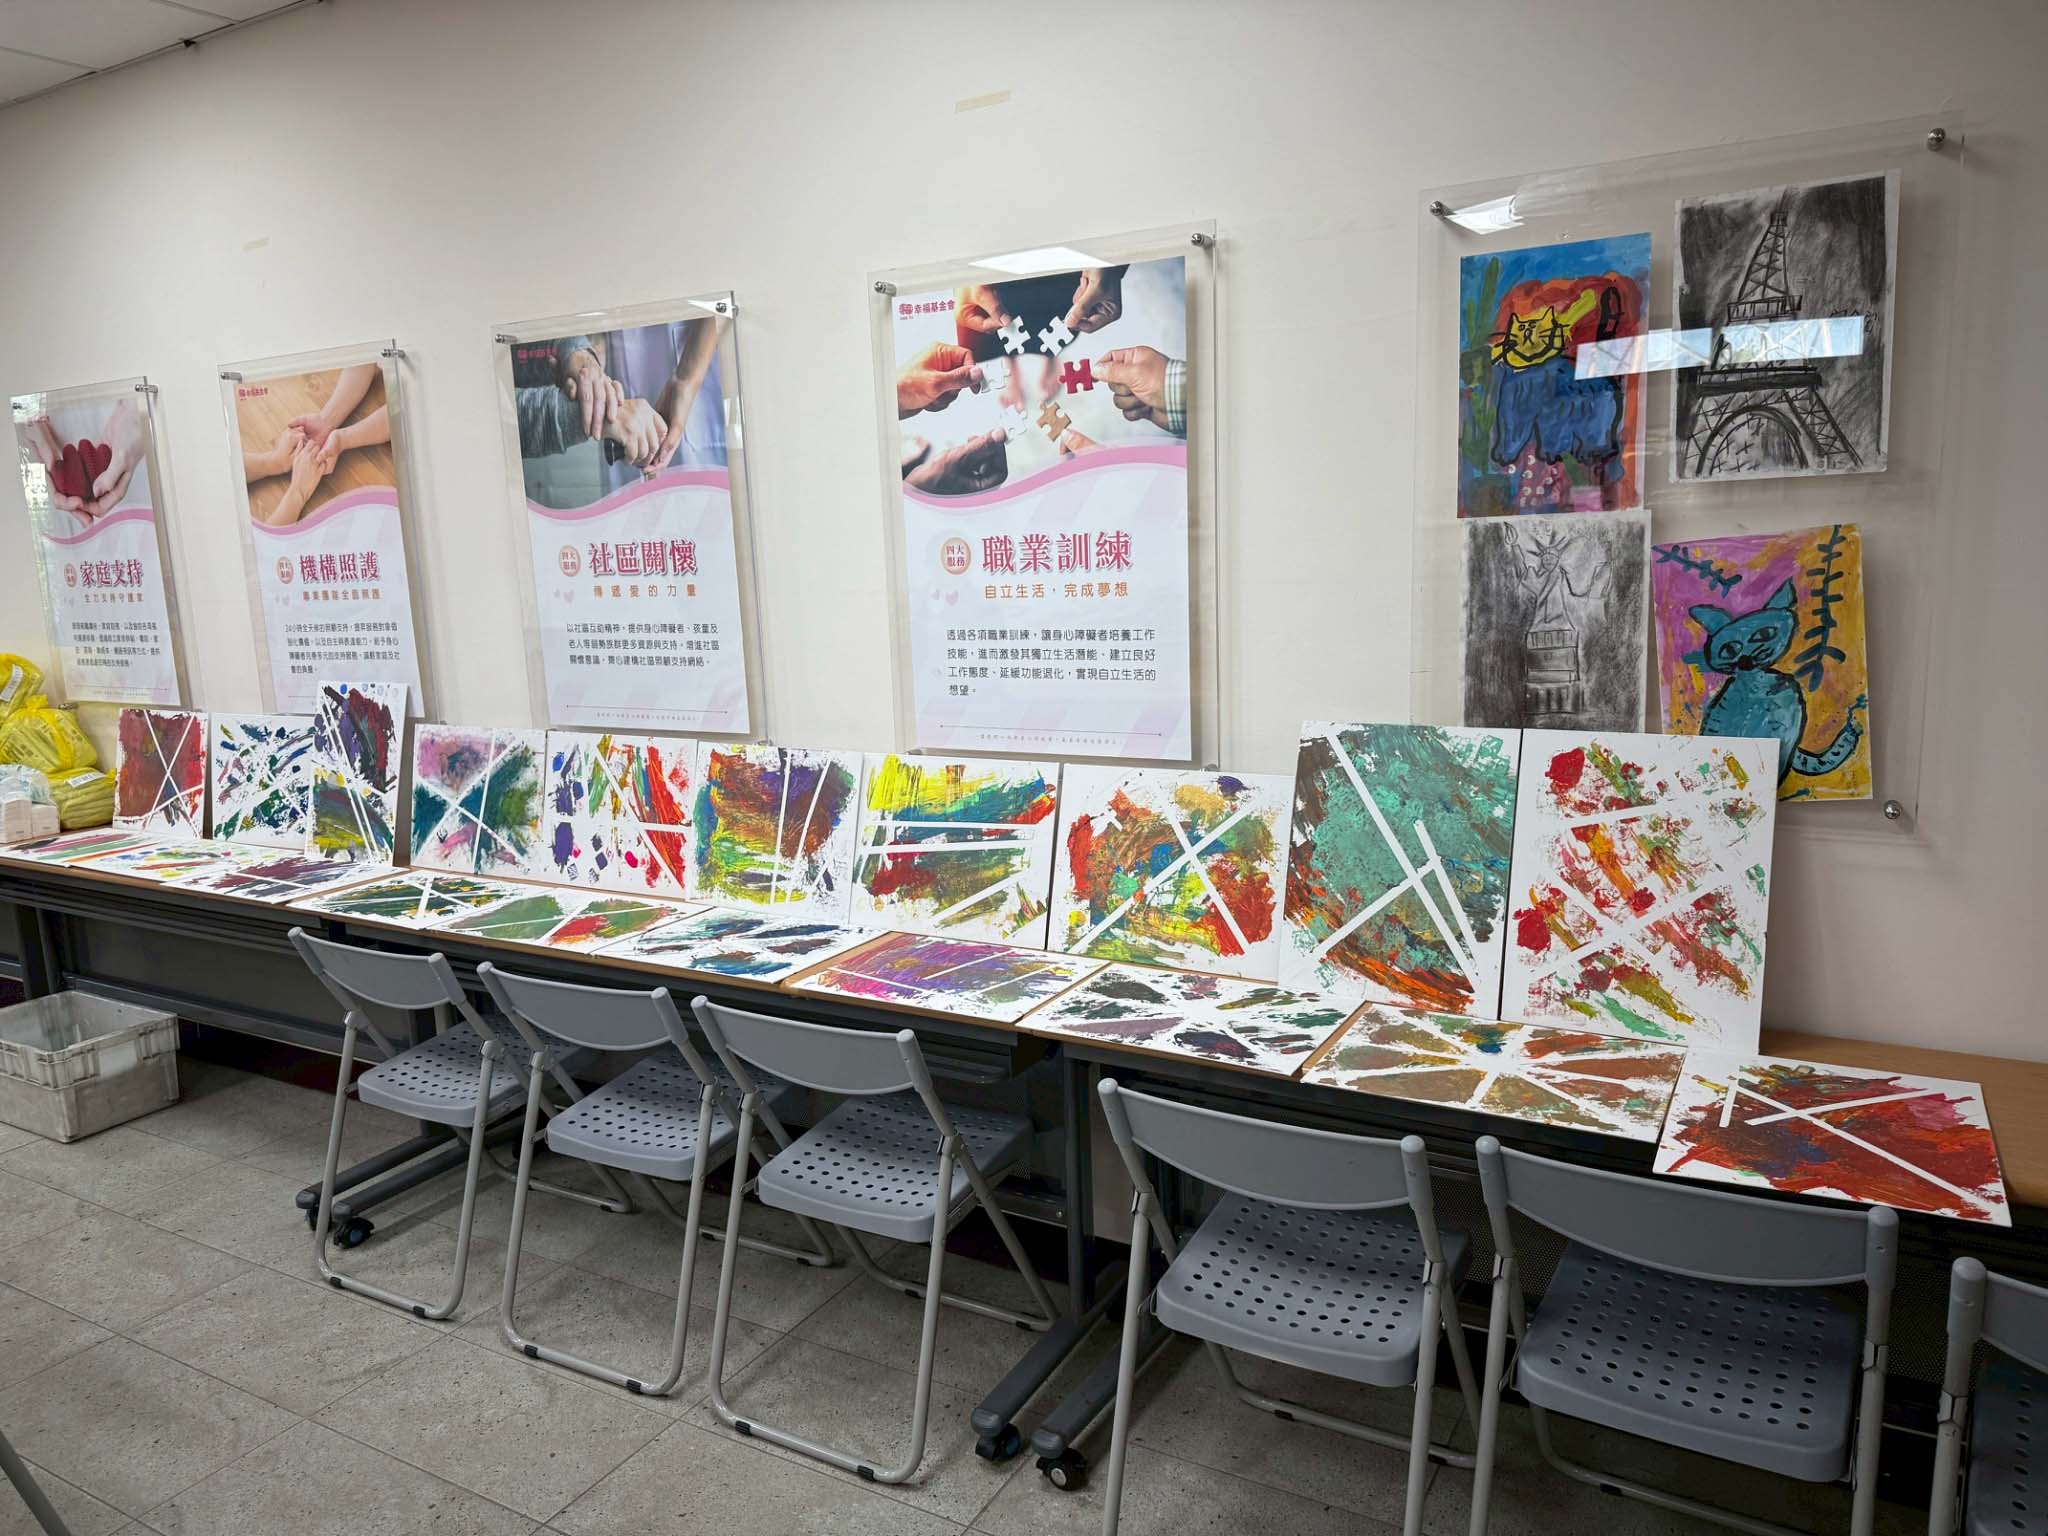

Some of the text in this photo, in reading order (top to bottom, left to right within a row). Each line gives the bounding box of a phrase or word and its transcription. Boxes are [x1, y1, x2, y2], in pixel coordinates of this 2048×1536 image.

[299, 551, 380, 583] 機構照護
[589, 538, 698, 577] 社區關懷
[981, 530, 1132, 573] 職業訓練
[80, 559, 144, 588] 家庭支持
